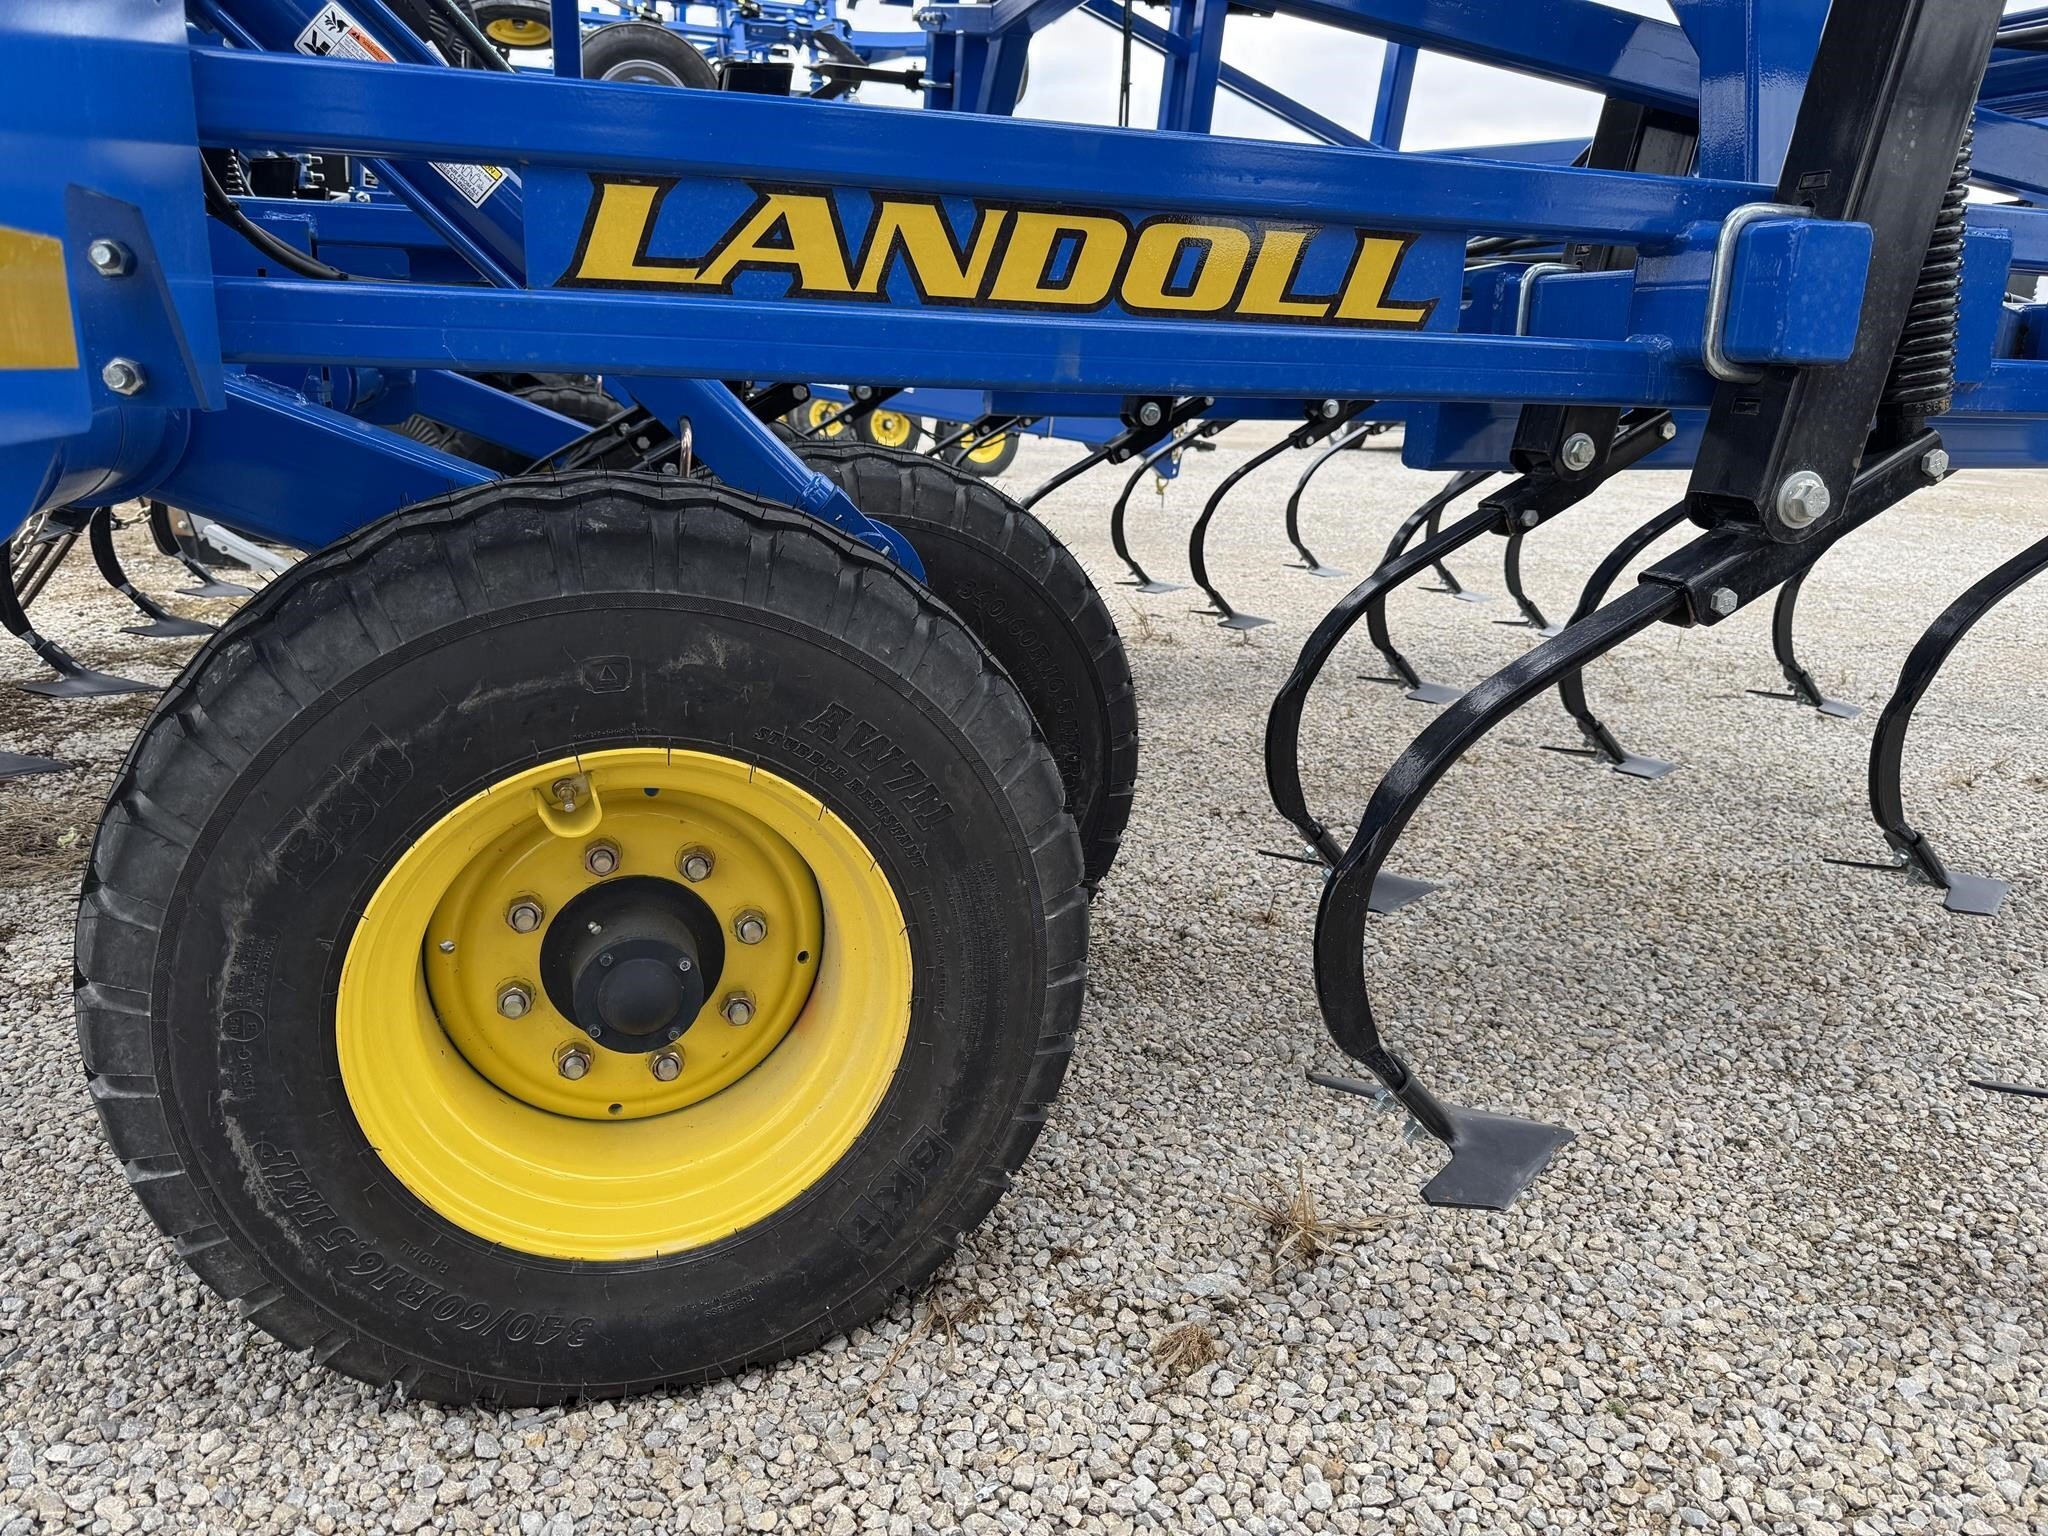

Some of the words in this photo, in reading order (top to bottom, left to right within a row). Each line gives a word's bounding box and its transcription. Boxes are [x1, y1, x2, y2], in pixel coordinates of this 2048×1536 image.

[560, 176, 1437, 327] LANDOLL
[753, 727, 849, 780] STUBBLE
[844, 777, 929, 868] RESISTANT
[251, 1141, 337, 1227] IMP
[314, 1226, 594, 1347] 340/60R16.5
[399, 1238, 449, 1275] RADIAL
